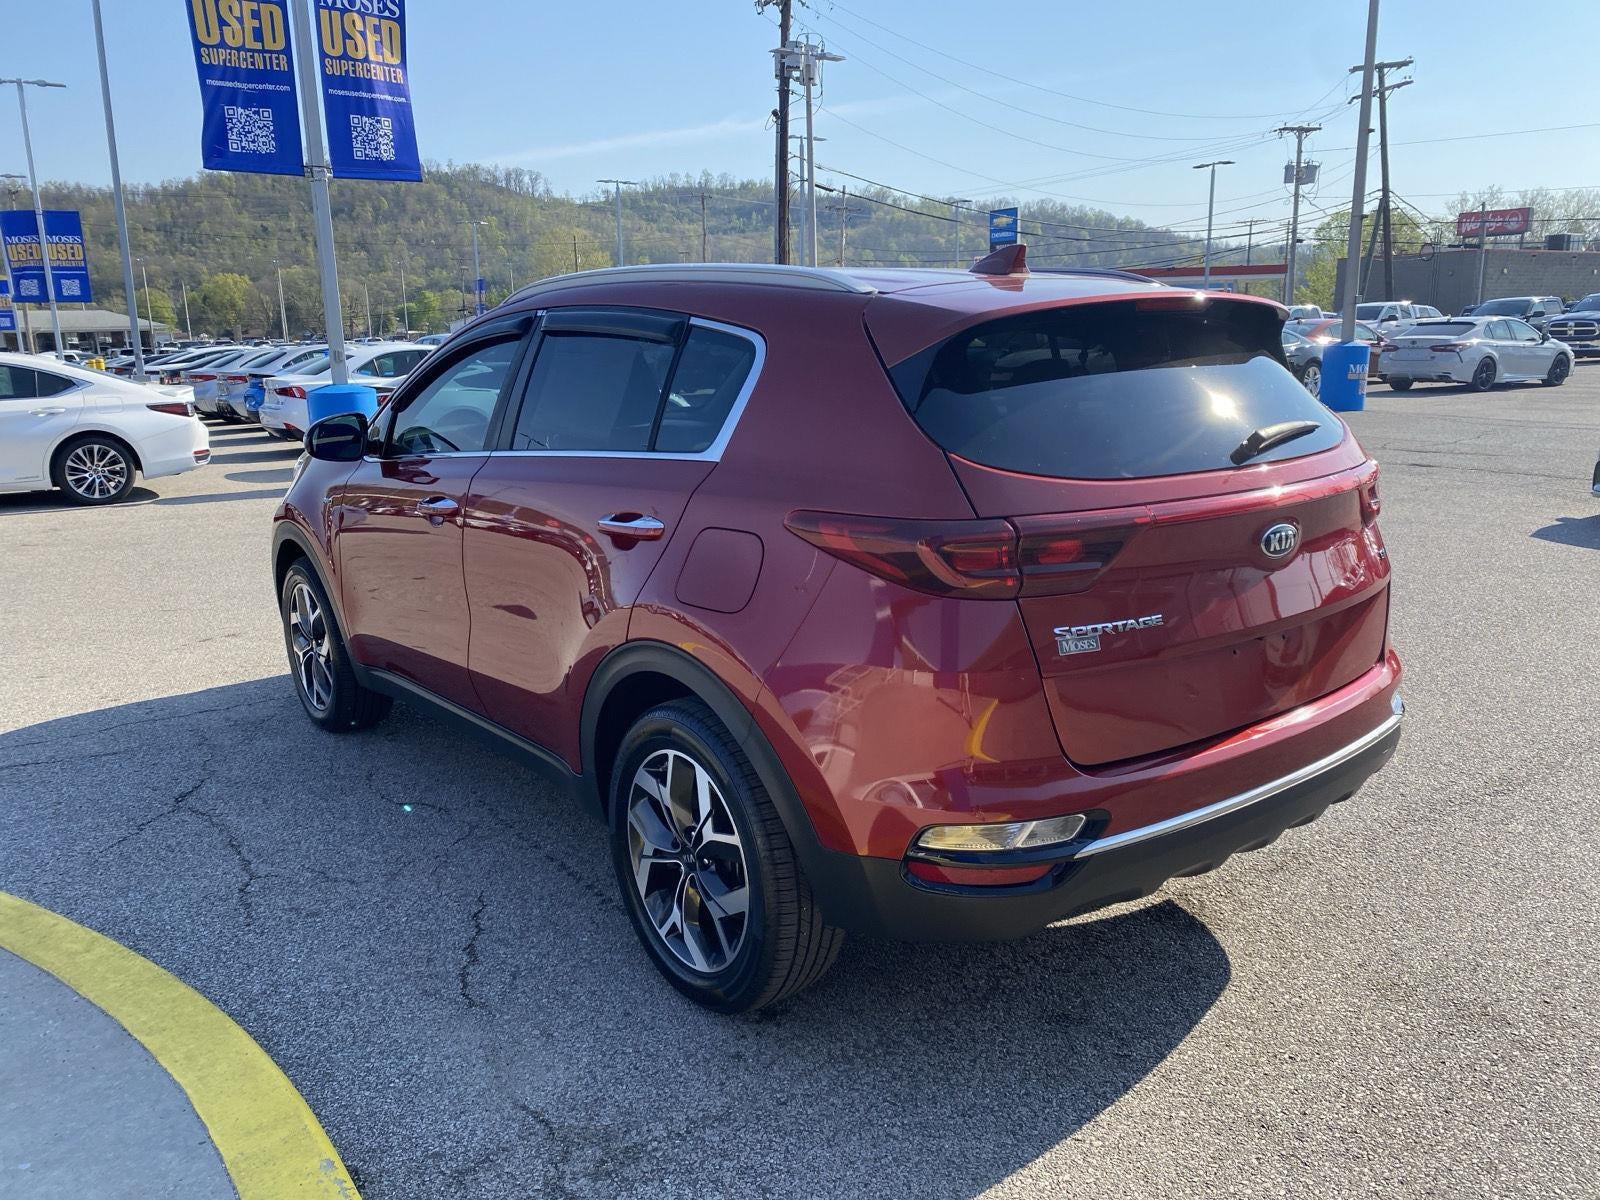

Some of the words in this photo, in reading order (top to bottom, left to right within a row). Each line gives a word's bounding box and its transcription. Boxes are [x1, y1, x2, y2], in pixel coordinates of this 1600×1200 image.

[192, 0, 285, 50] USED
[320, 9, 401, 65] USED
[201, 47, 288, 71] SUPERCENTER
[325, 58, 404, 84] SUPERCENTER
[5, 235, 39, 244] MOSES
[46, 235, 81, 243] MOSES
[6, 243, 41, 261] USED
[47, 243, 84, 260] USED
[1269, 530, 1294, 552] KIA
[1053, 614, 1164, 639] SPORTAGE
[1062, 639, 1097, 653] MOSES
